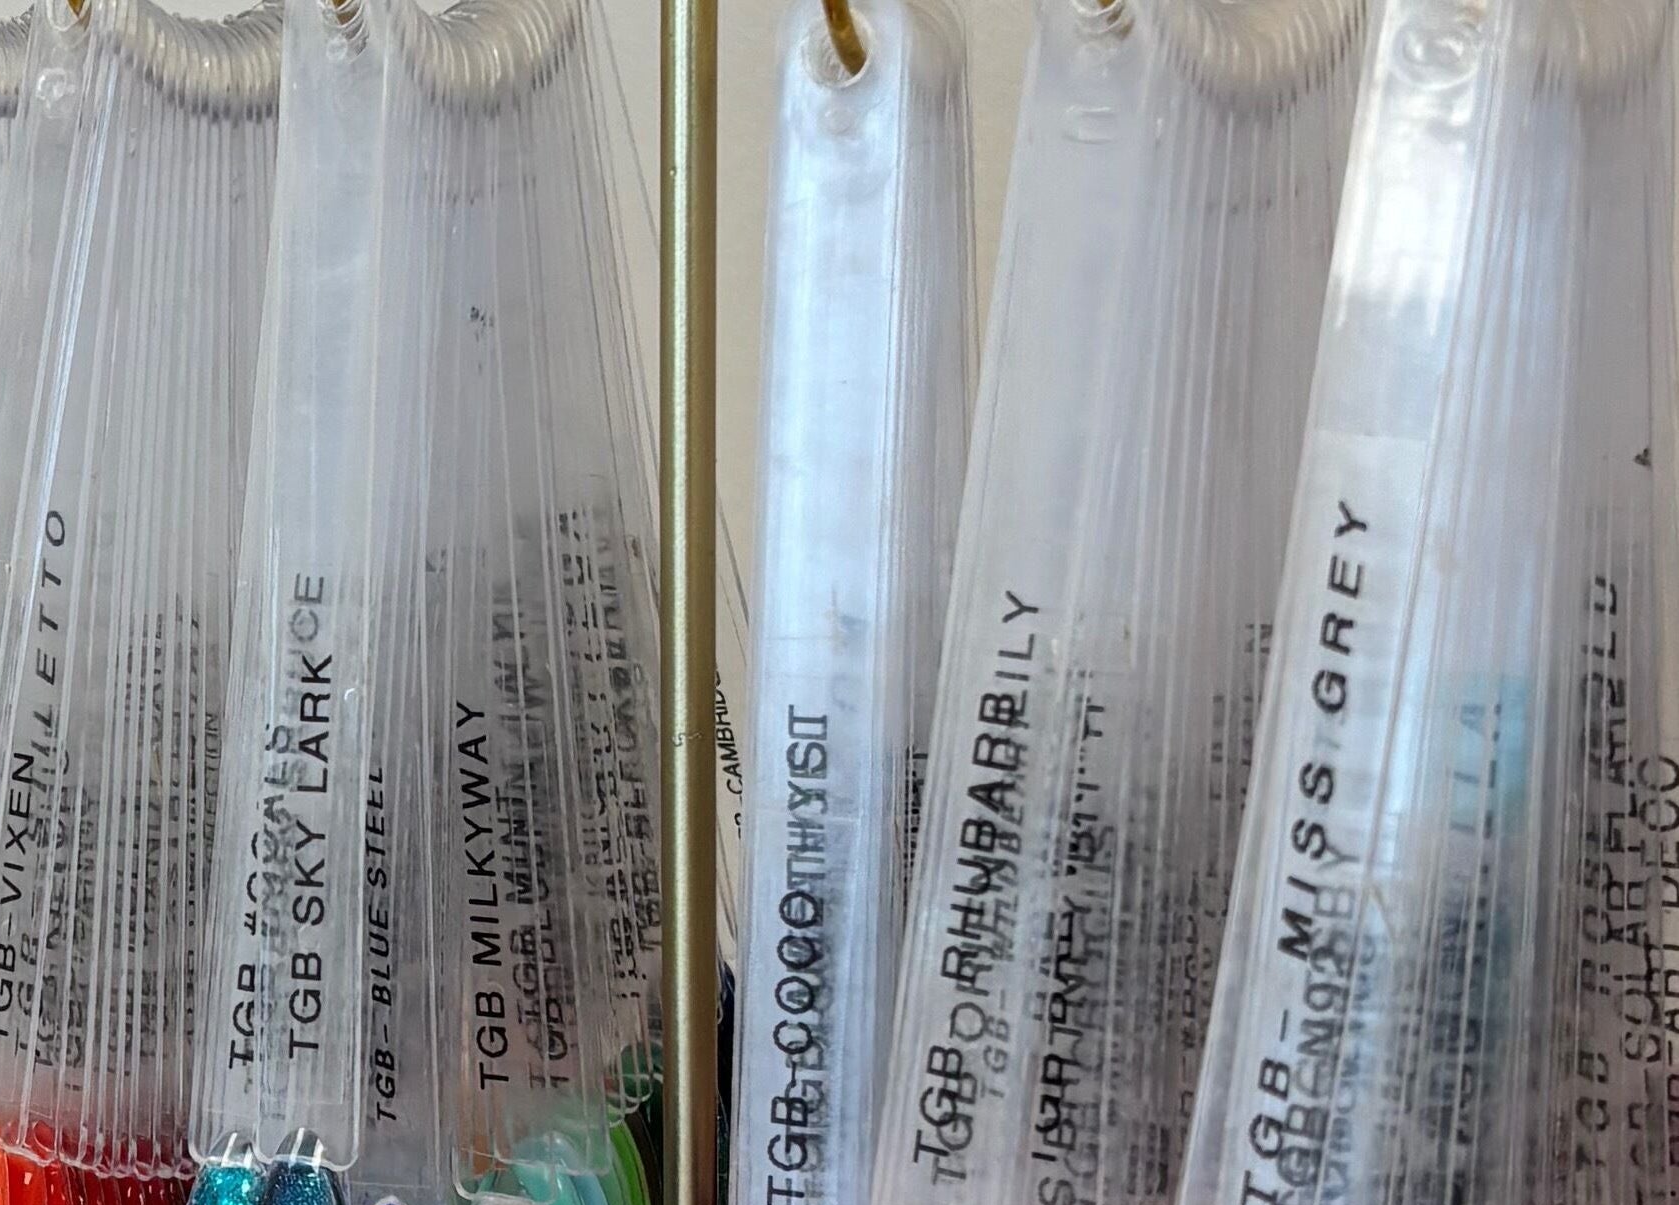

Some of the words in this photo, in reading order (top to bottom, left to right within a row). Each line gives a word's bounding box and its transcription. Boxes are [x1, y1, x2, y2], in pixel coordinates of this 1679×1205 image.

[297, 653, 333, 793] LARK
[1276, 760, 1334, 961] MISS
[1312, 500, 1368, 714] GREY
[293, 816, 326, 927] SKY
[364, 764, 389, 890] STEEL
[455, 699, 503, 968] MILKYWAY
[289, 951, 323, 1059] TGB
[367, 906, 392, 1007] BLUE
[474, 990, 510, 1090] TGB
[912, 1044, 965, 1164] TGB
